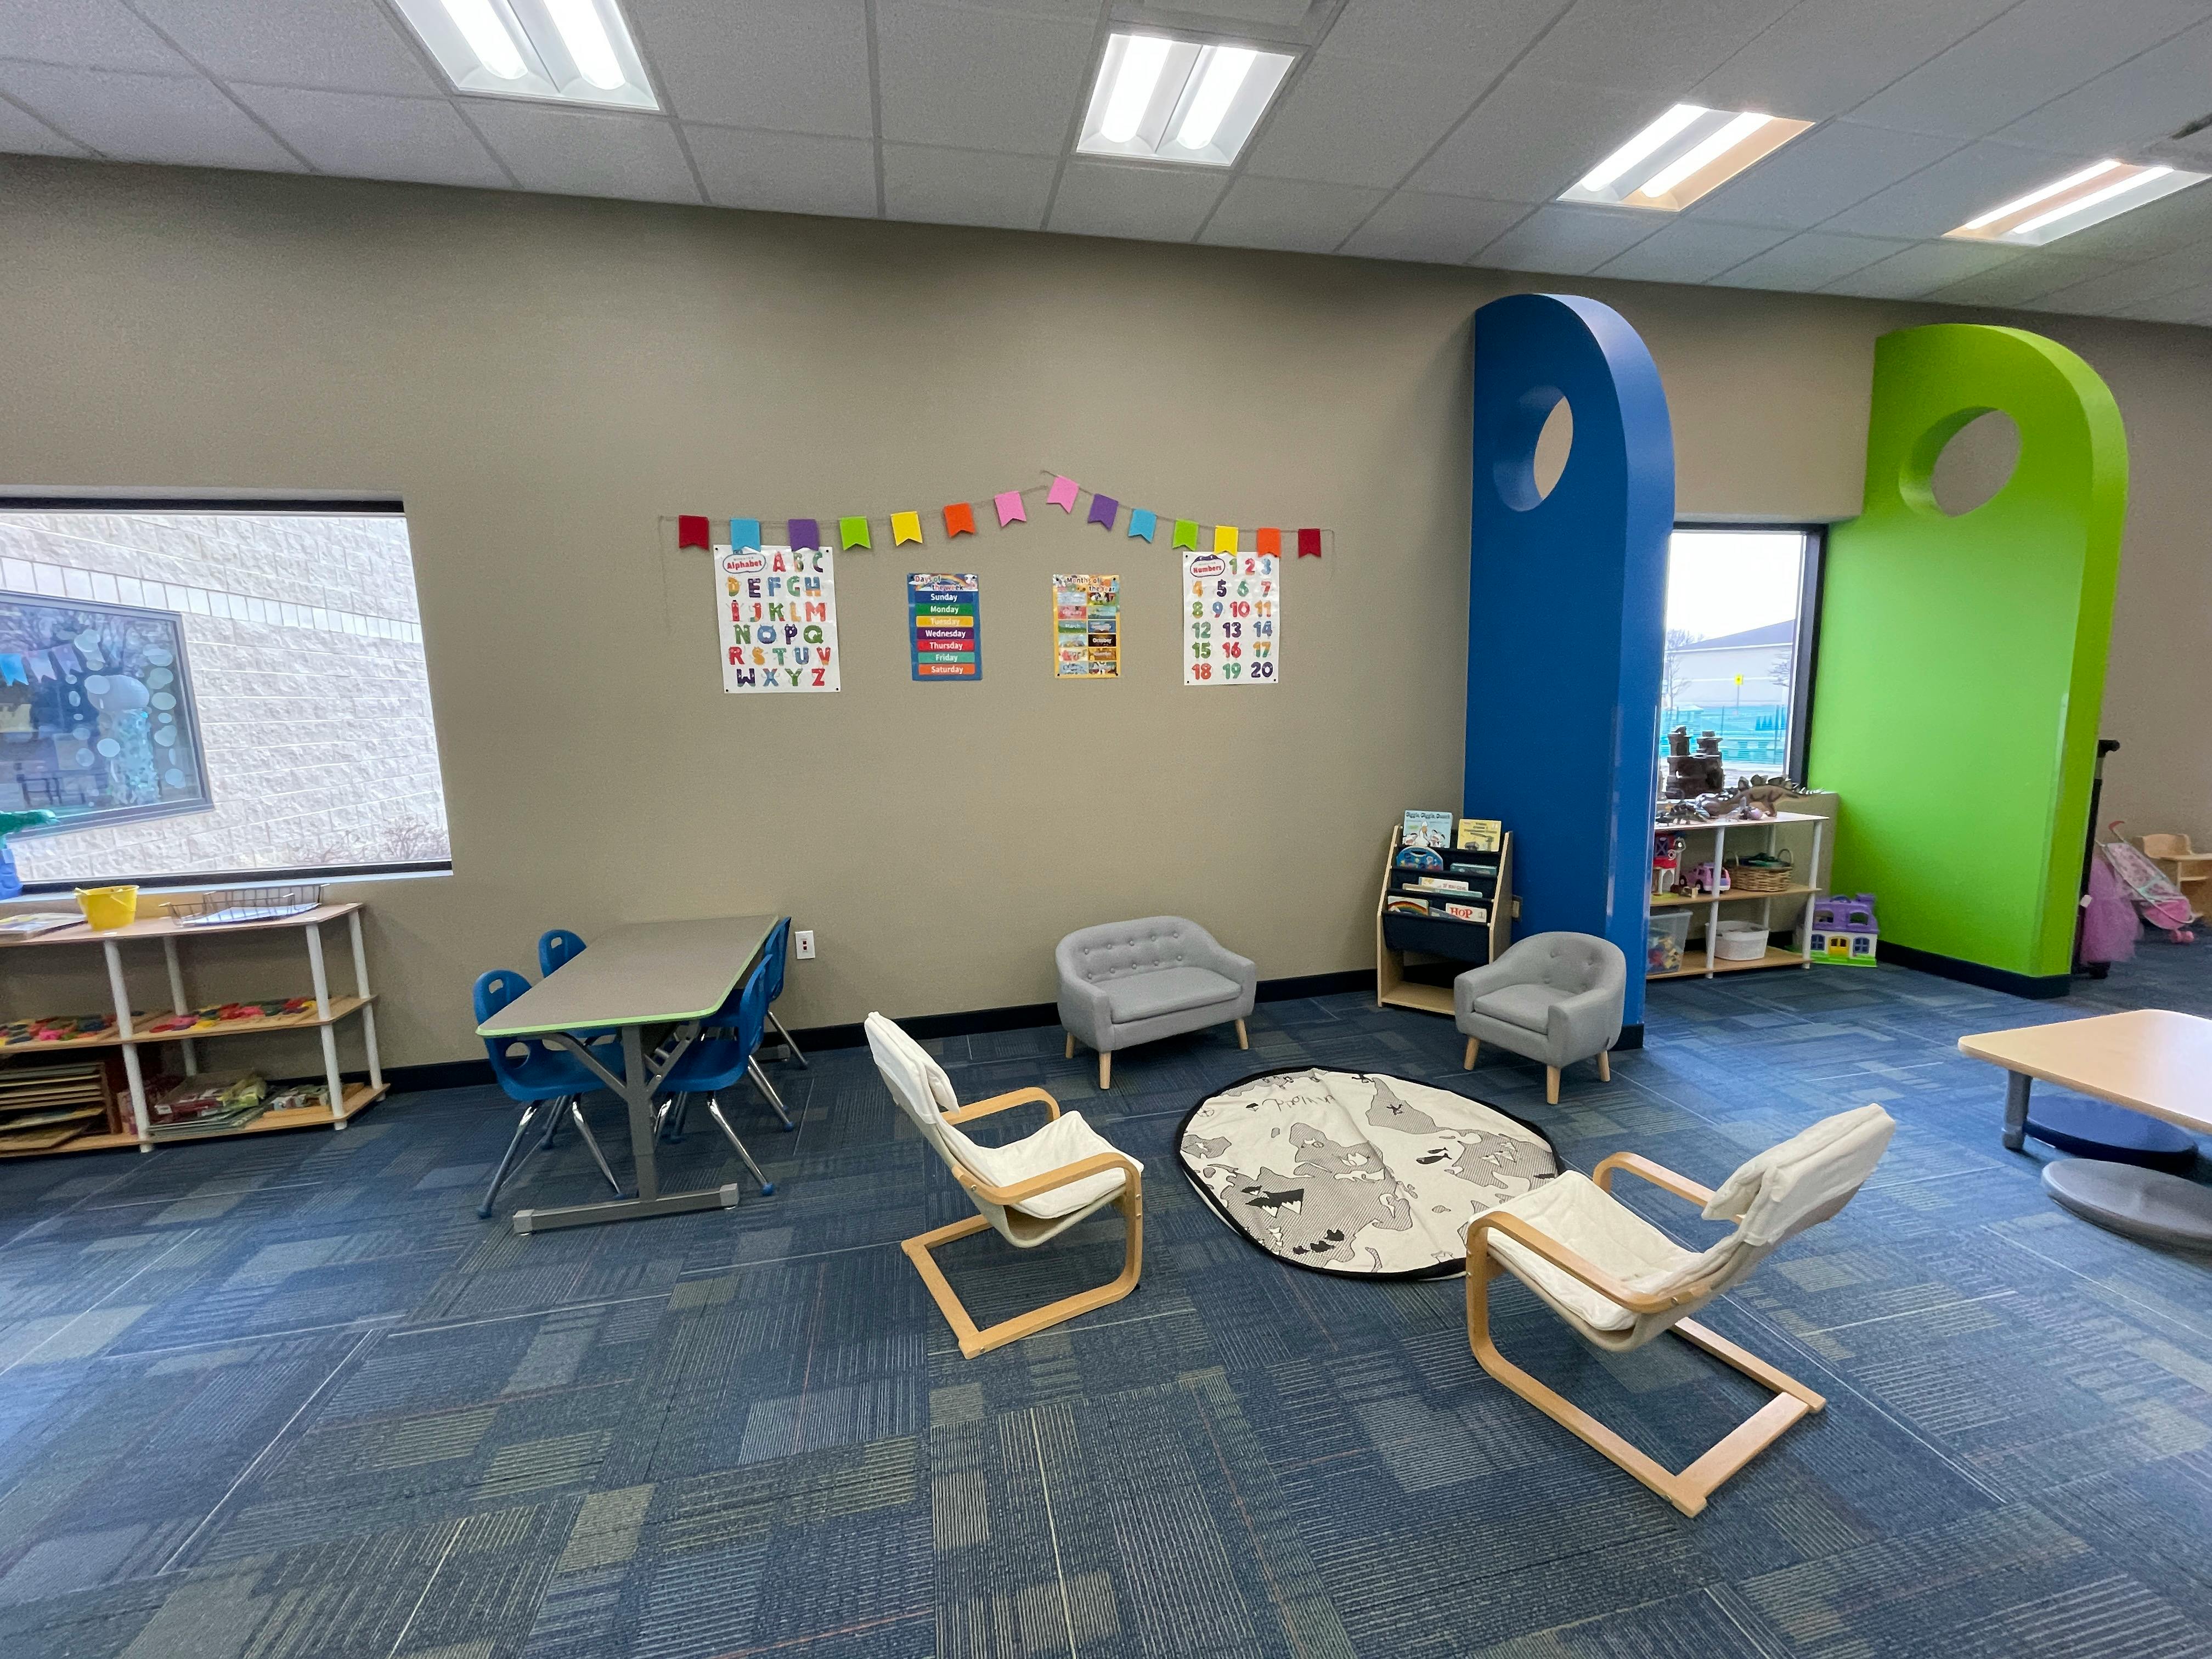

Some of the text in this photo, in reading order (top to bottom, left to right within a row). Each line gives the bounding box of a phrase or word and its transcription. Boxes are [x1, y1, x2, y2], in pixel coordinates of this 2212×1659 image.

[727, 560, 762, 570] Alphabet
[773, 551, 823, 573] A B C
[1229, 558, 1271, 575] 1 2 3
[727, 575, 821, 597] D E F G H
[1193, 580, 1271, 597] 4 5 6 7
[930, 594, 957, 602] Sunday
[731, 600, 826, 622] I J K L M
[930, 606, 959, 614] Monday
[1193, 600, 1271, 618] 8 9 10 11
[733, 624, 823, 644] N O P Q
[926, 630, 966, 638] Wednesday
[1192, 621, 1272, 639] 12 13 14
[929, 642, 963, 651] Thursday
[1192, 641, 1271, 658] 15 16 17
[729, 647, 831, 665] R S T U V
[936, 654, 958, 662] Friday
[737, 668, 825, 687] W X Y Z
[931, 666, 963, 674] Saturday
[1192, 662, 1273, 680] 18 19 20
[1450, 907, 1472, 918] HOP
